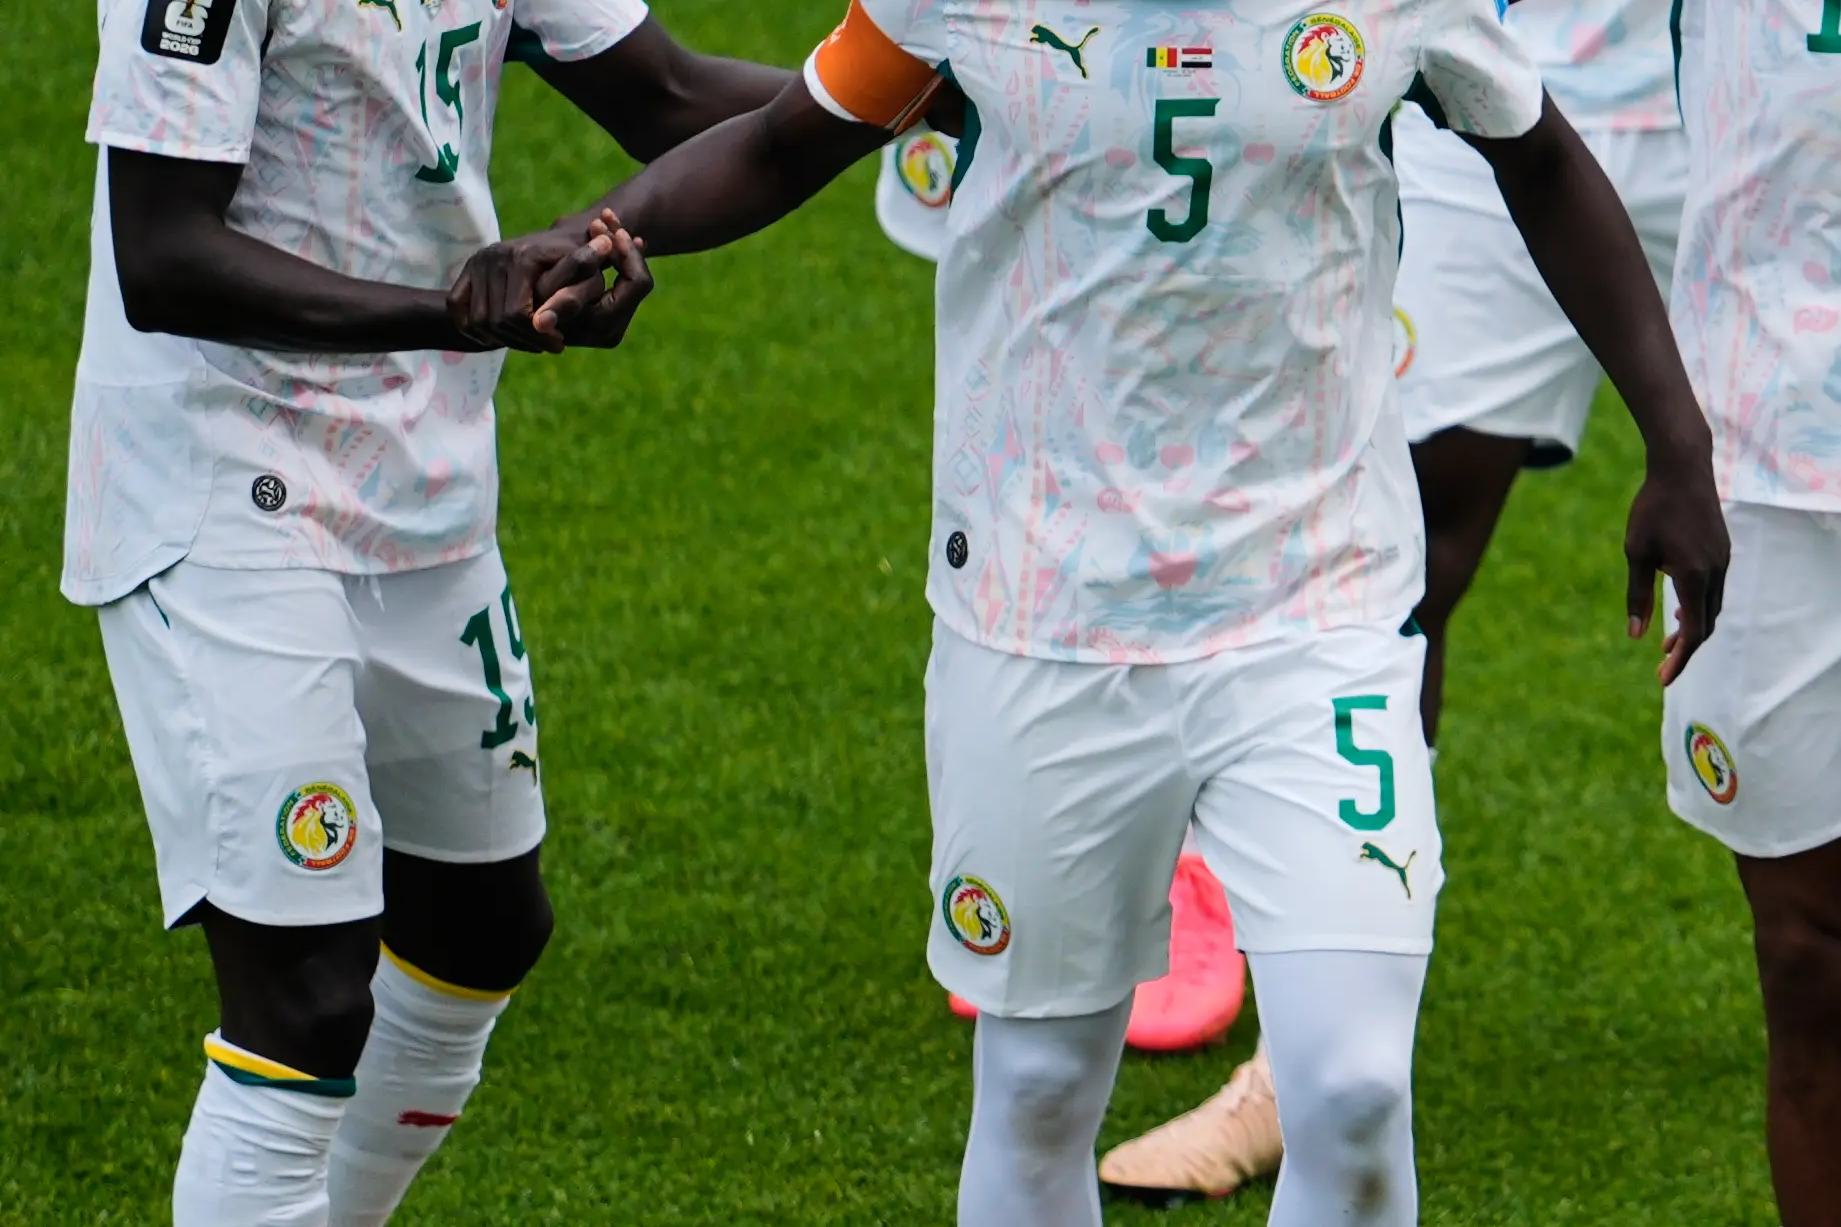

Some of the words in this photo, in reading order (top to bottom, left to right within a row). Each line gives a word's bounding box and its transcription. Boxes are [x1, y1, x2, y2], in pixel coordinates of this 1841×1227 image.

[159, 38, 200, 56] 2026
[414, 20, 482, 183] 15
[1146, 98, 1220, 244] 5
[1331, 694, 1396, 831] 5
